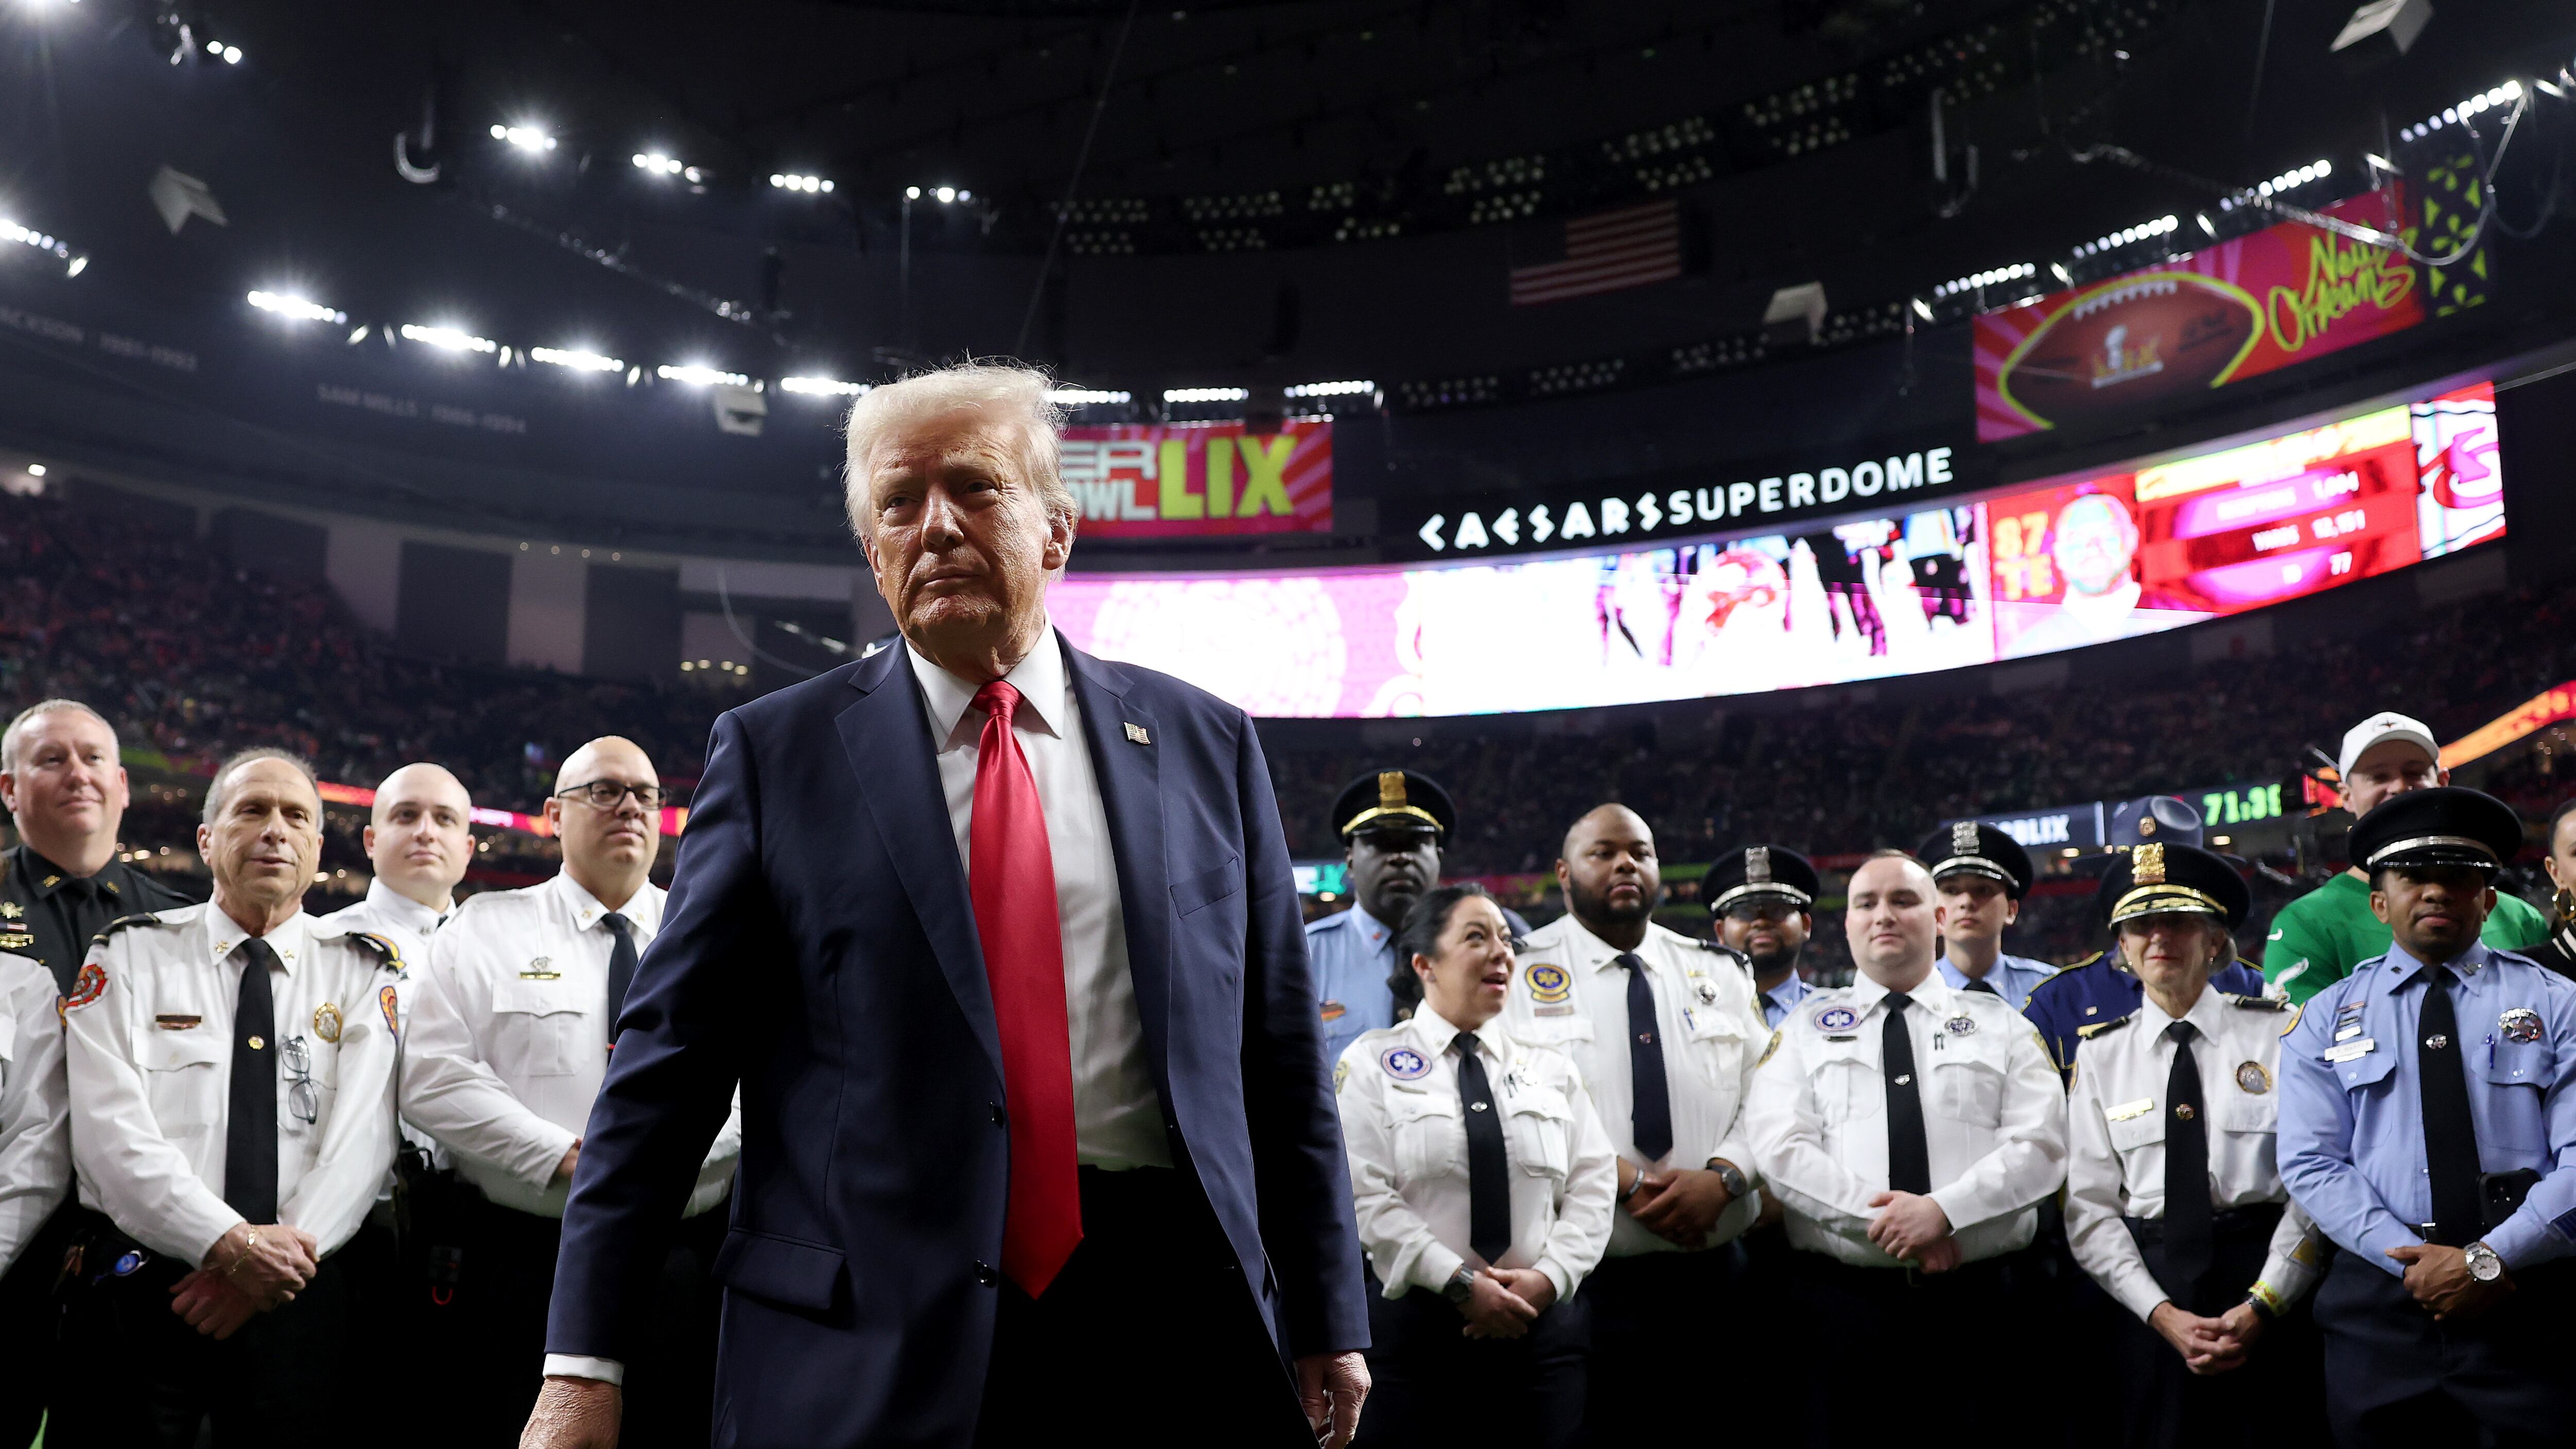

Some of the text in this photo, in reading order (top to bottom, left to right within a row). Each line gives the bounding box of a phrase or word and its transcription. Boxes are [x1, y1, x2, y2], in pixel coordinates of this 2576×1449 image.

[1069, 479, 1157, 521] WL
[1159, 434, 1297, 520] LIX
[1418, 447, 1954, 551] CAESARS SUPERDOME
[1994, 511, 2049, 559] 87
[1993, 552, 2053, 601] TE
[2329, 551, 2352, 575] 77
